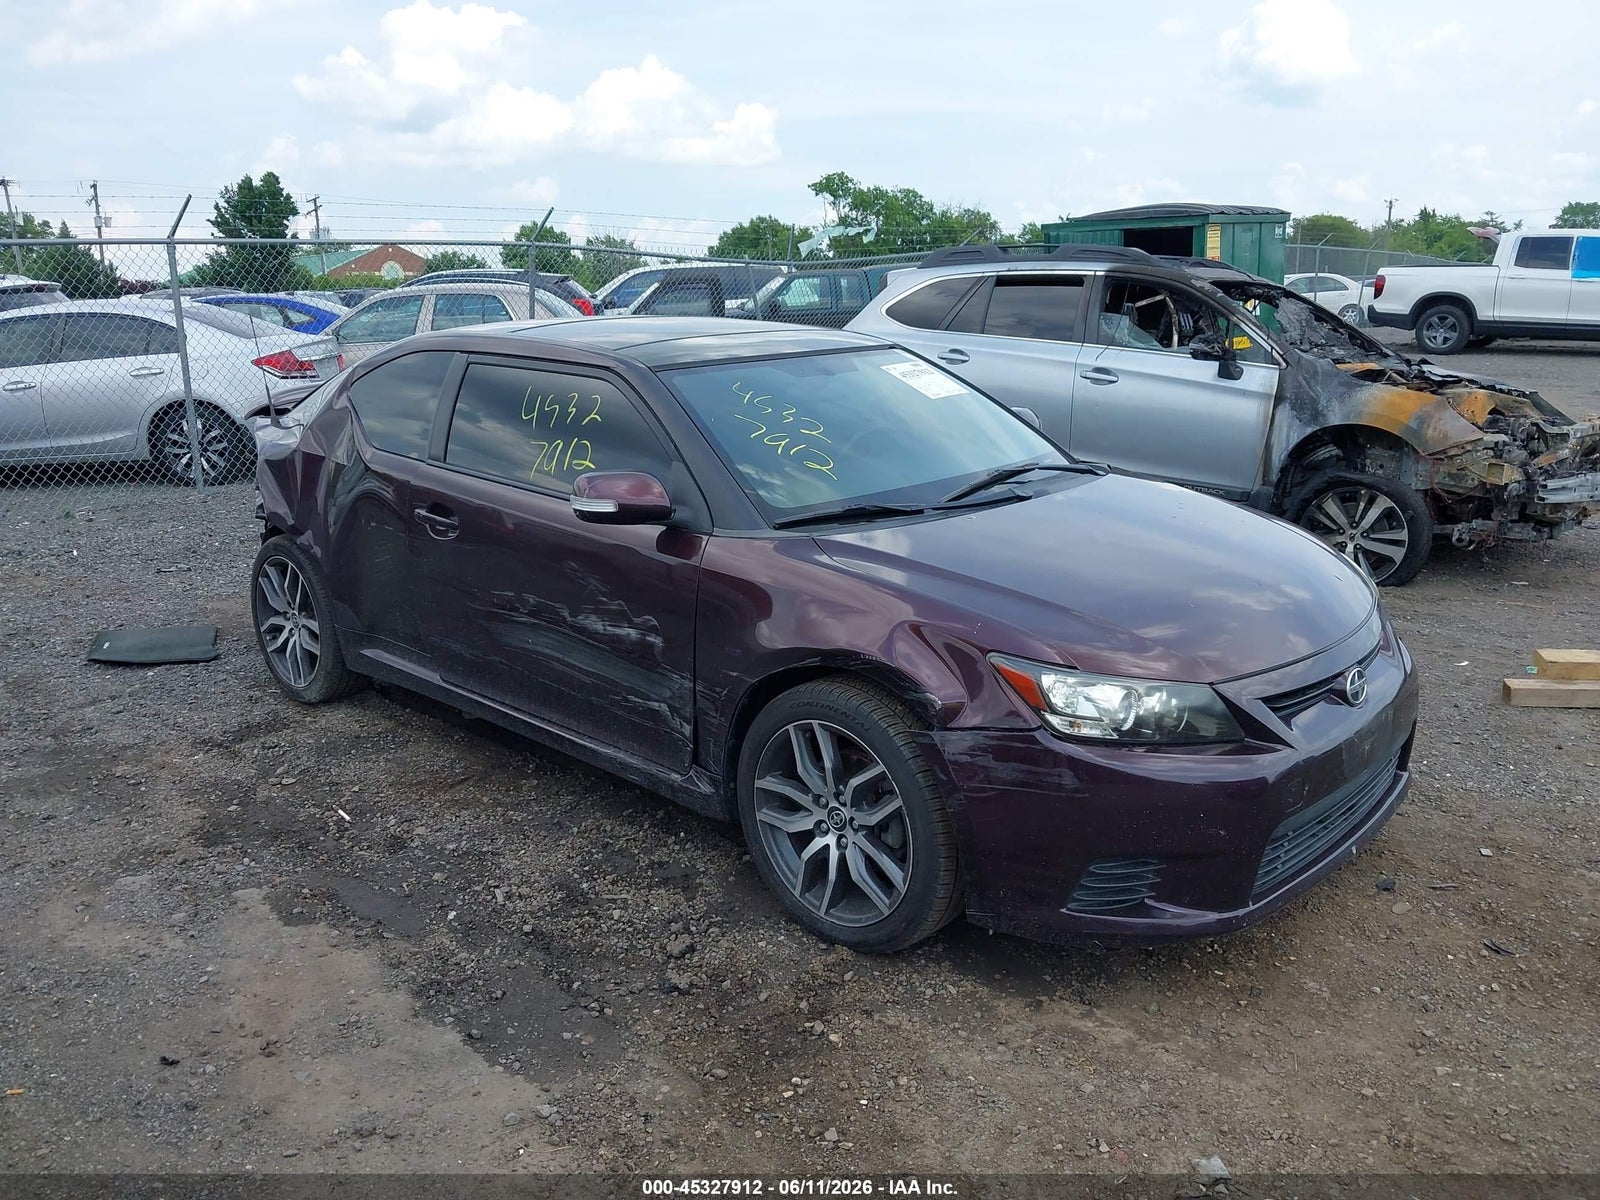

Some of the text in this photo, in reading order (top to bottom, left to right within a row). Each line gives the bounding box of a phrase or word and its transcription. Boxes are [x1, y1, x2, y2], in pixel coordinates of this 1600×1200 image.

[522, 385, 602, 430] 4532
[732, 382, 832, 443] 4532
[530, 437, 596, 480] 7912
[734, 414, 838, 480] 7912
